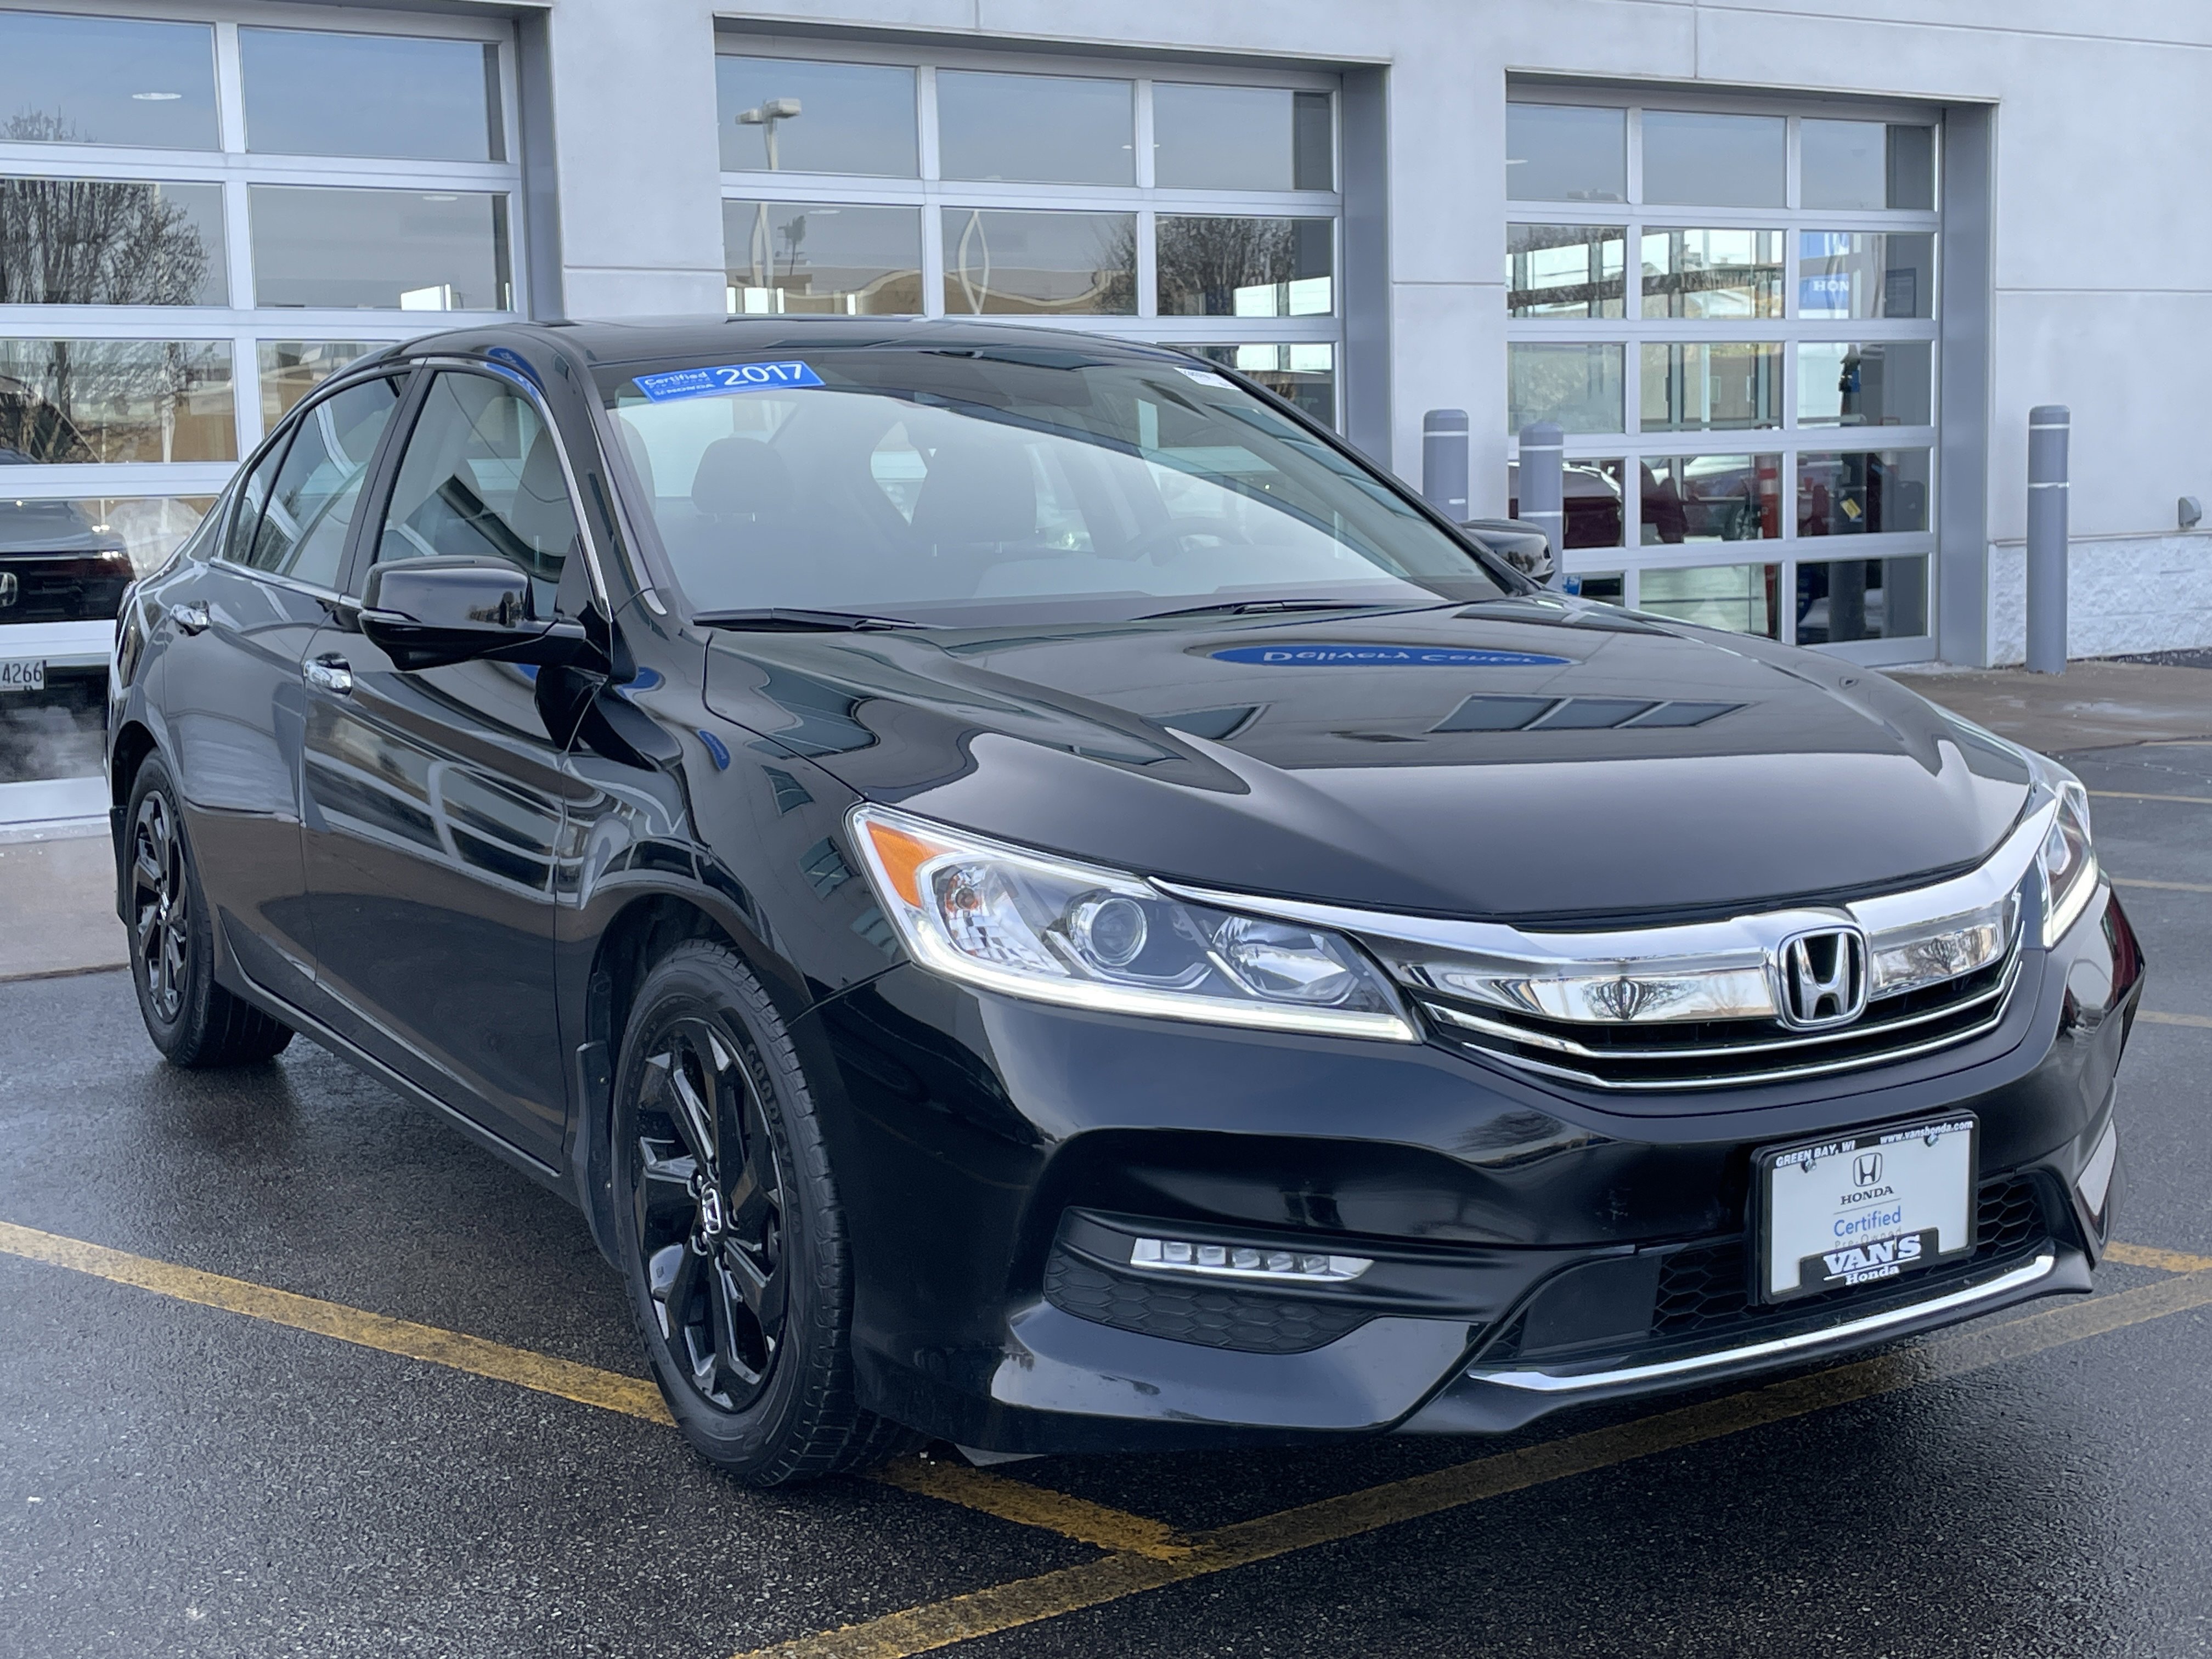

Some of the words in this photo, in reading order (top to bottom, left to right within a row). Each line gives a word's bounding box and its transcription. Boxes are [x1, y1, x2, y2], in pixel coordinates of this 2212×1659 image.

[644, 371, 708, 386] Certified
[716, 363, 802, 386] 2017
[2, 662, 42, 684] 4266
[1880, 1120, 1973, 1144] www.vanshonda.com
[1776, 1149, 1812, 1168] GREEN
[1813, 1143, 1840, 1159] BAY,
[1841, 1139, 1856, 1153] WI
[1839, 1186, 1894, 1205] HONDA
[1833, 1205, 1902, 1237] Certified
[1845, 1265, 1900, 1286] Honda
